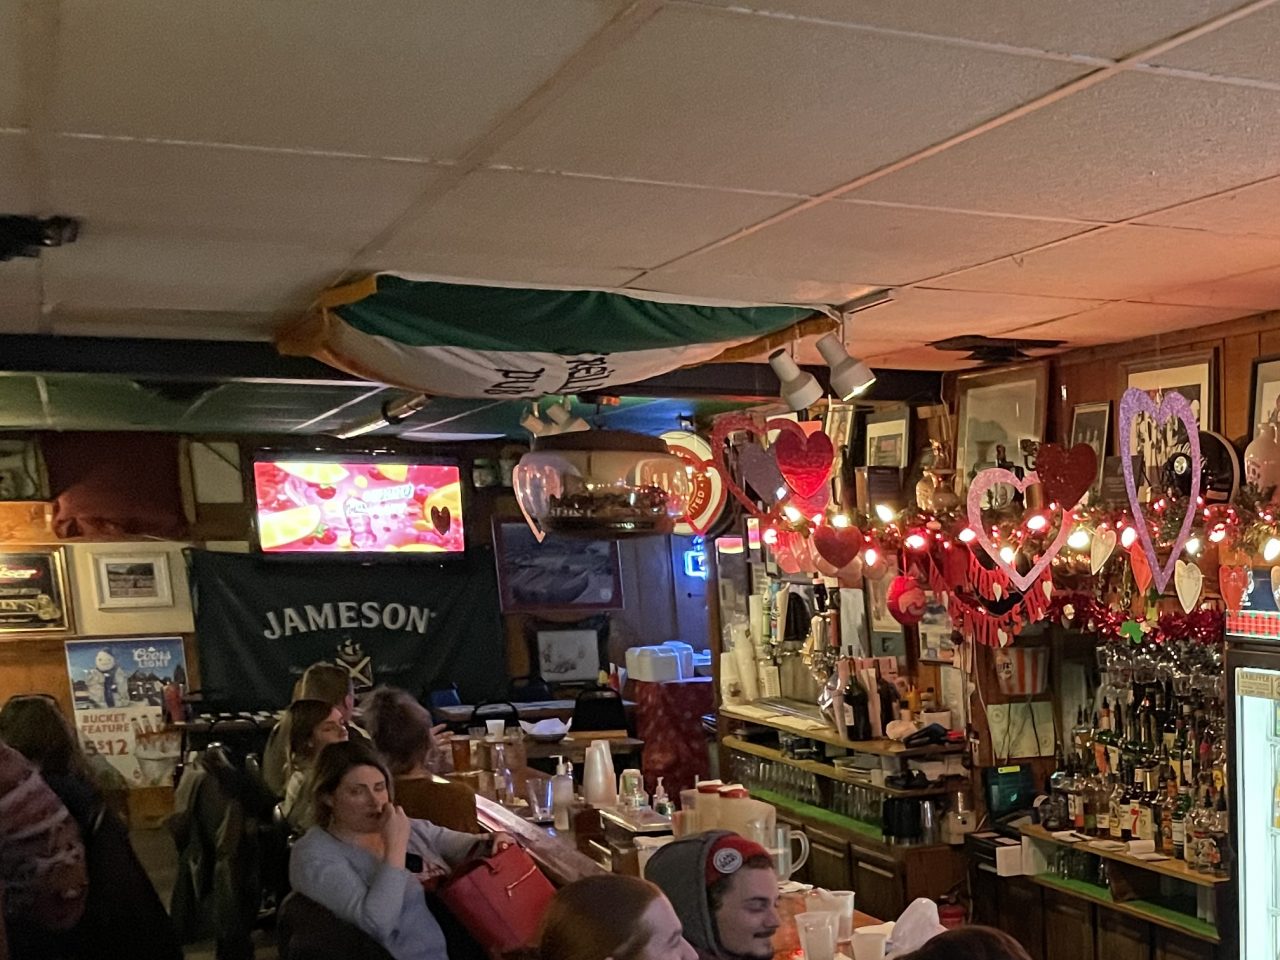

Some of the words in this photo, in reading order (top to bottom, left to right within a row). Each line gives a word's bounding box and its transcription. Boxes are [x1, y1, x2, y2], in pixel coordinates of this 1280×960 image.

[263, 601, 431, 640] JAMESON
[132, 646, 172, 661] Coors
[138, 659, 170, 668] LIGHT
[82, 713, 127, 723] BUCKET
[81, 722, 131, 735] FEATURE
